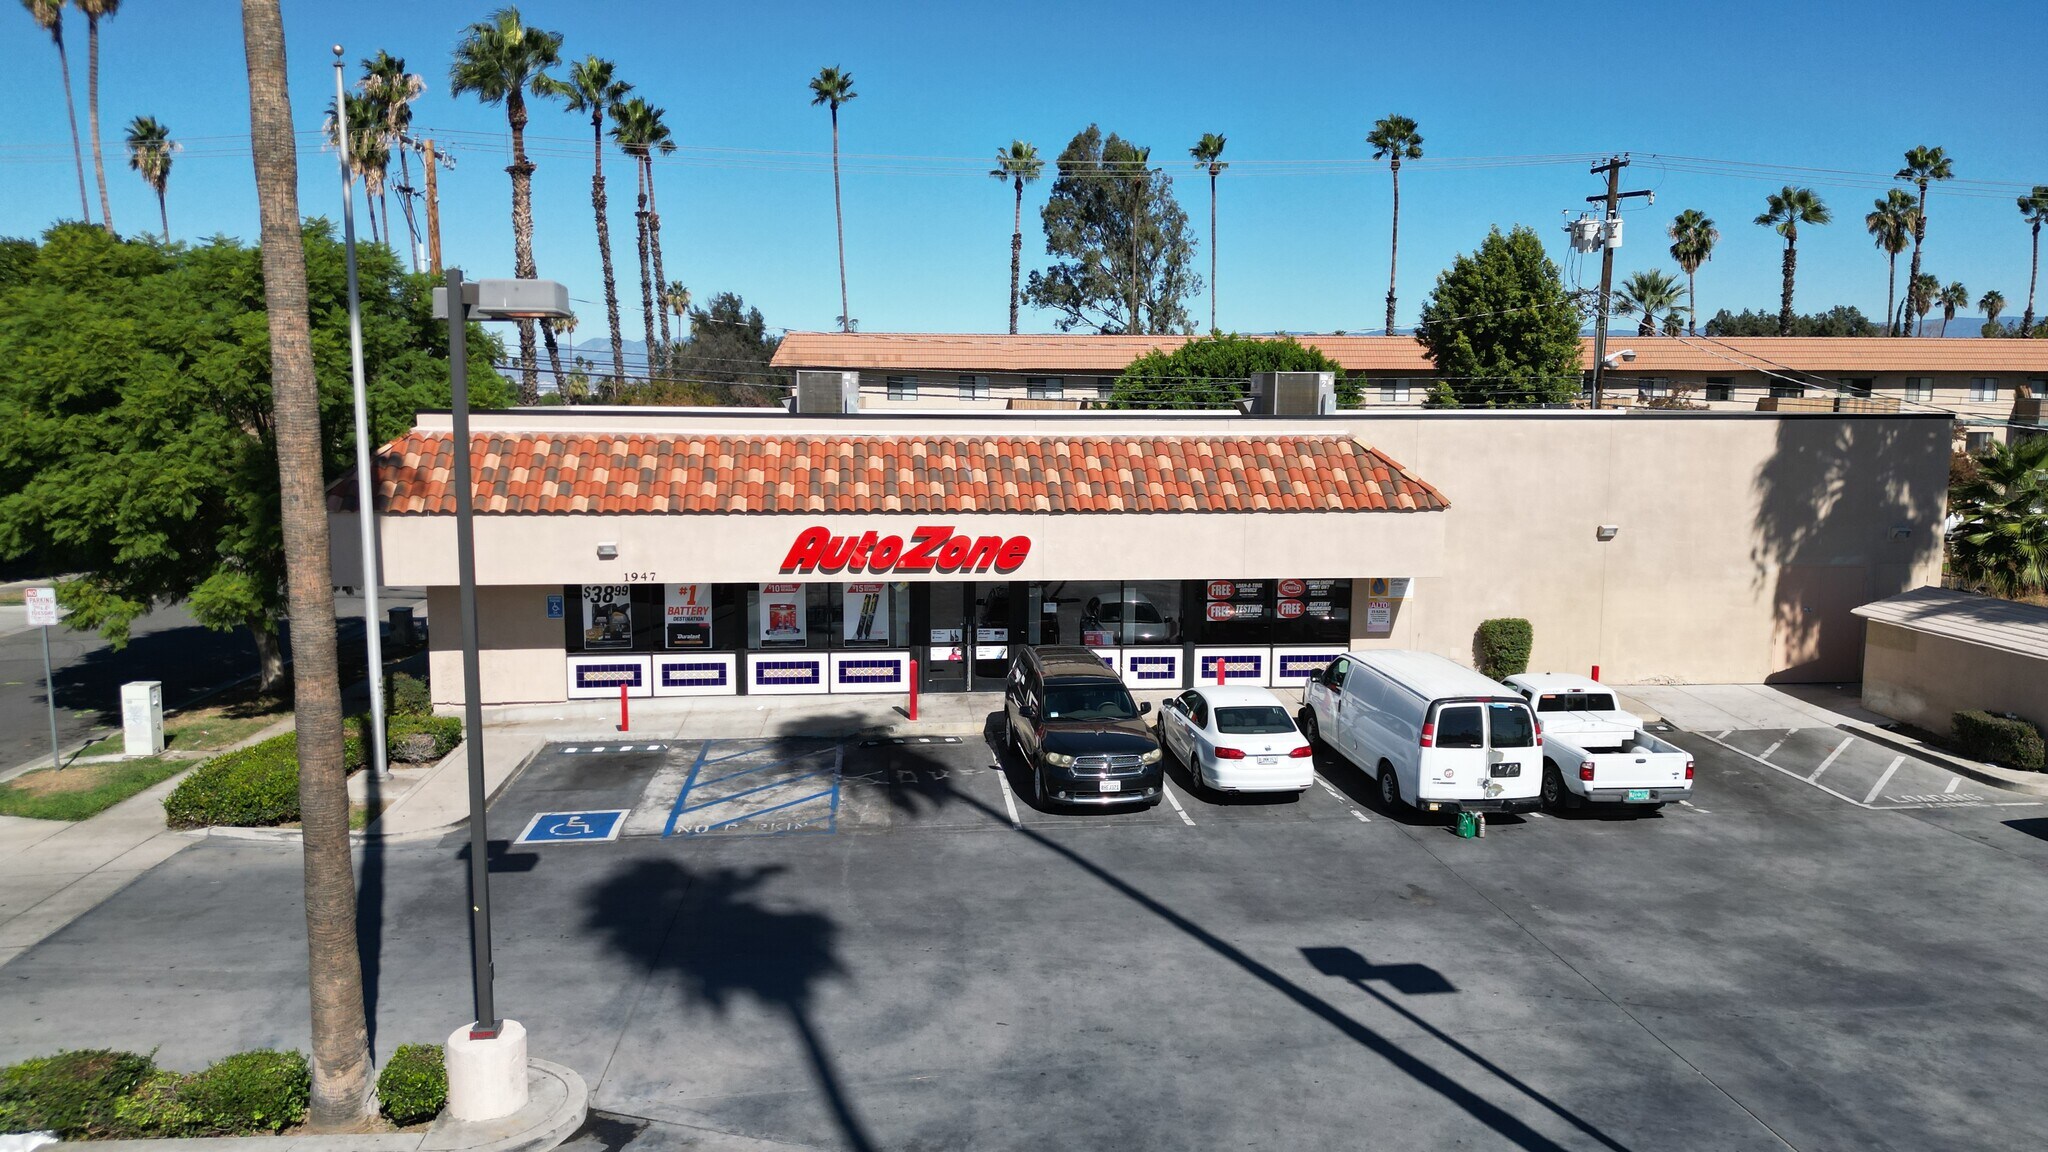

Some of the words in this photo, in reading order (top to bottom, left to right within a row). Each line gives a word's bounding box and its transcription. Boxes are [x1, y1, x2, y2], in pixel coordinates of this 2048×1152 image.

[1321, 380, 1327, 388] 2
[778, 525, 1032, 574] AutoZone
[624, 572, 656, 582] 1947
[768, 583, 780, 592] $10
[848, 584, 864, 592] $15
[1211, 584, 1231, 596] FREE
[27, 589, 36, 597] NO
[678, 584, 697, 605] #1
[667, 606, 709, 616] BATTERY
[1210, 605, 1231, 617] FREE
[1235, 604, 1263, 614] TESTING
[1281, 603, 1301, 615] FREE
[1883, 794, 1985, 803] LOADING
[677, 823, 710, 834] NO
